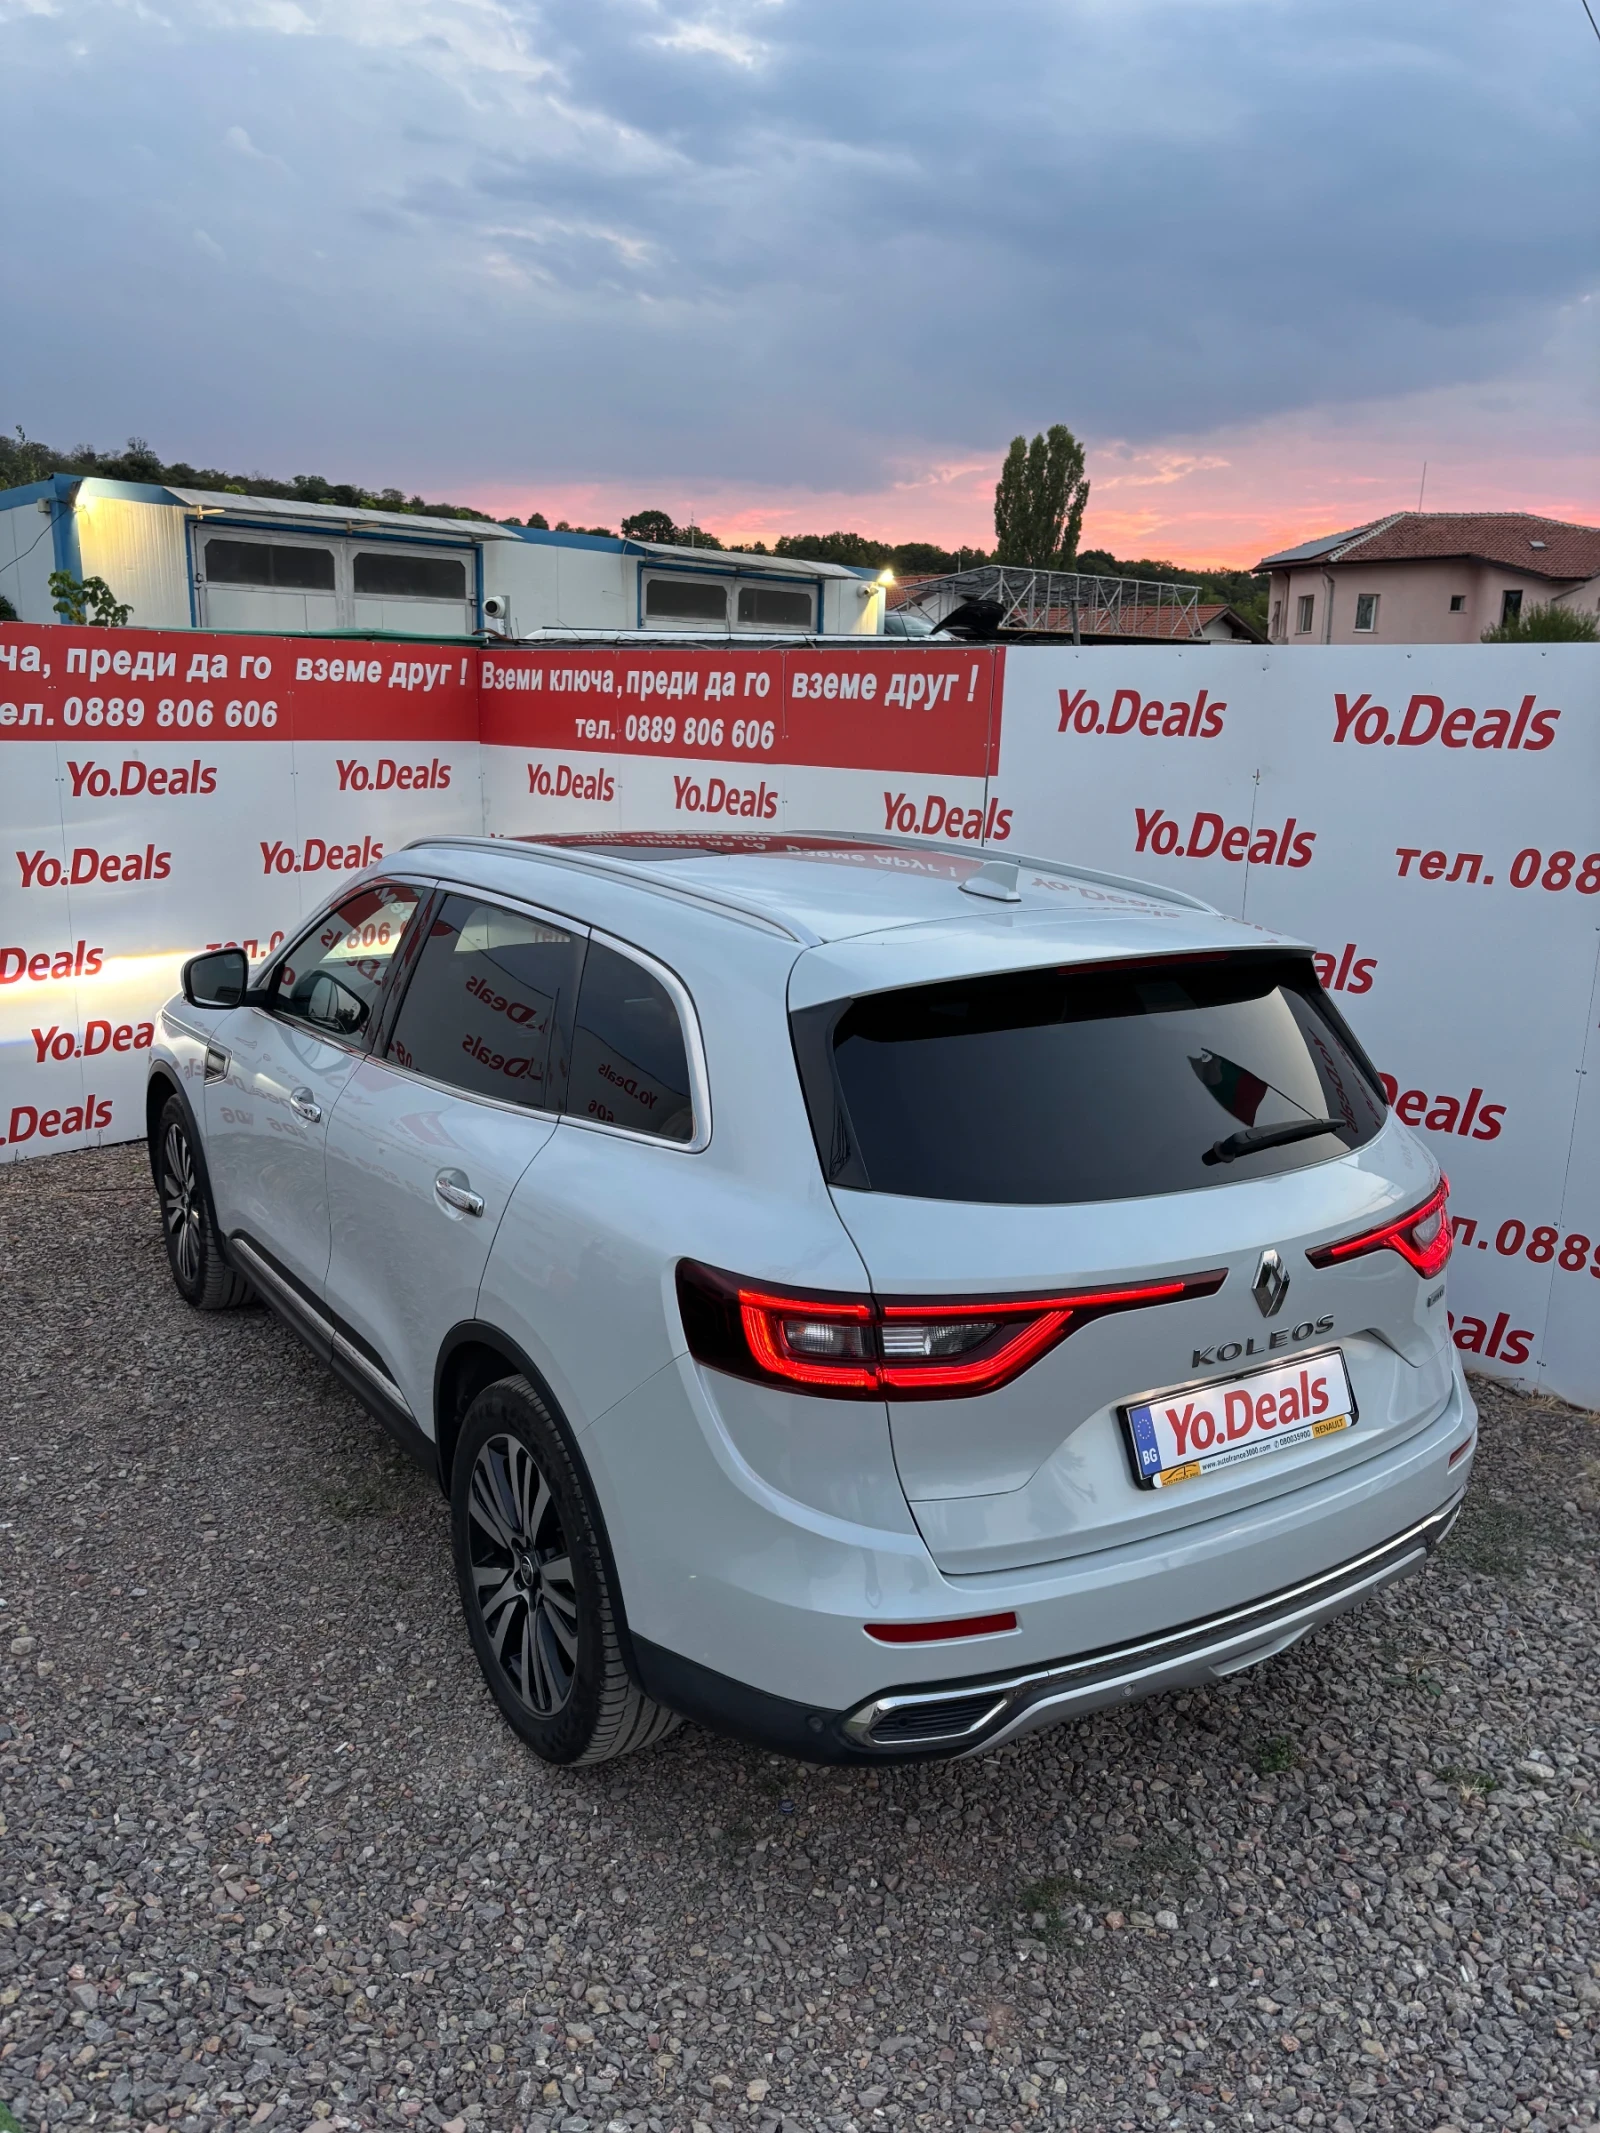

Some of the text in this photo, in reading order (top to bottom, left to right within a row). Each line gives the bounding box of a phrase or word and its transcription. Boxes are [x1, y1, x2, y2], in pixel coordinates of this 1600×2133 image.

[66, 647, 177, 683] преди
[185, 653, 228, 684] да
[239, 655, 272, 680] го
[295, 657, 383, 683] вземе
[387, 661, 453, 692] друг
[459, 657, 468, 686] !
[481, 661, 543, 691] Вземи
[626, 670, 699, 702] преди
[703, 671, 736, 702] да
[743, 671, 771, 698] го
[791, 672, 878, 701] вземе
[883, 673, 960, 711] друг
[966, 664, 979, 702] !
[63, 696, 145, 727] 0889
[156, 698, 214, 728] 806
[224, 699, 278, 728] 606
[575, 714, 775, 750] тел. 0889 806 606
[1058, 689, 1227, 739] Yo.Deals
[1333, 693, 1561, 751] Yo.Deals
[67, 759, 217, 797] Yo.Deals
[335, 758, 451, 791] Yo.Deals
[527, 763, 615, 802] Yo.Deals
[673, 775, 778, 819] Yo.Deals
[883, 792, 1013, 841] Yo.Deals
[1135, 808, 1316, 868] Yo.Deals
[15, 843, 171, 888] Yo.Deals
[1396, 848, 1493, 885] тел.
[1192, 1313, 1335, 1368] KOLEOS
[1164, 1370, 1330, 1456] Yo.Deals
[1314, 1418, 1344, 1437] RENAULT
[1142, 1449, 1158, 1466] BG
